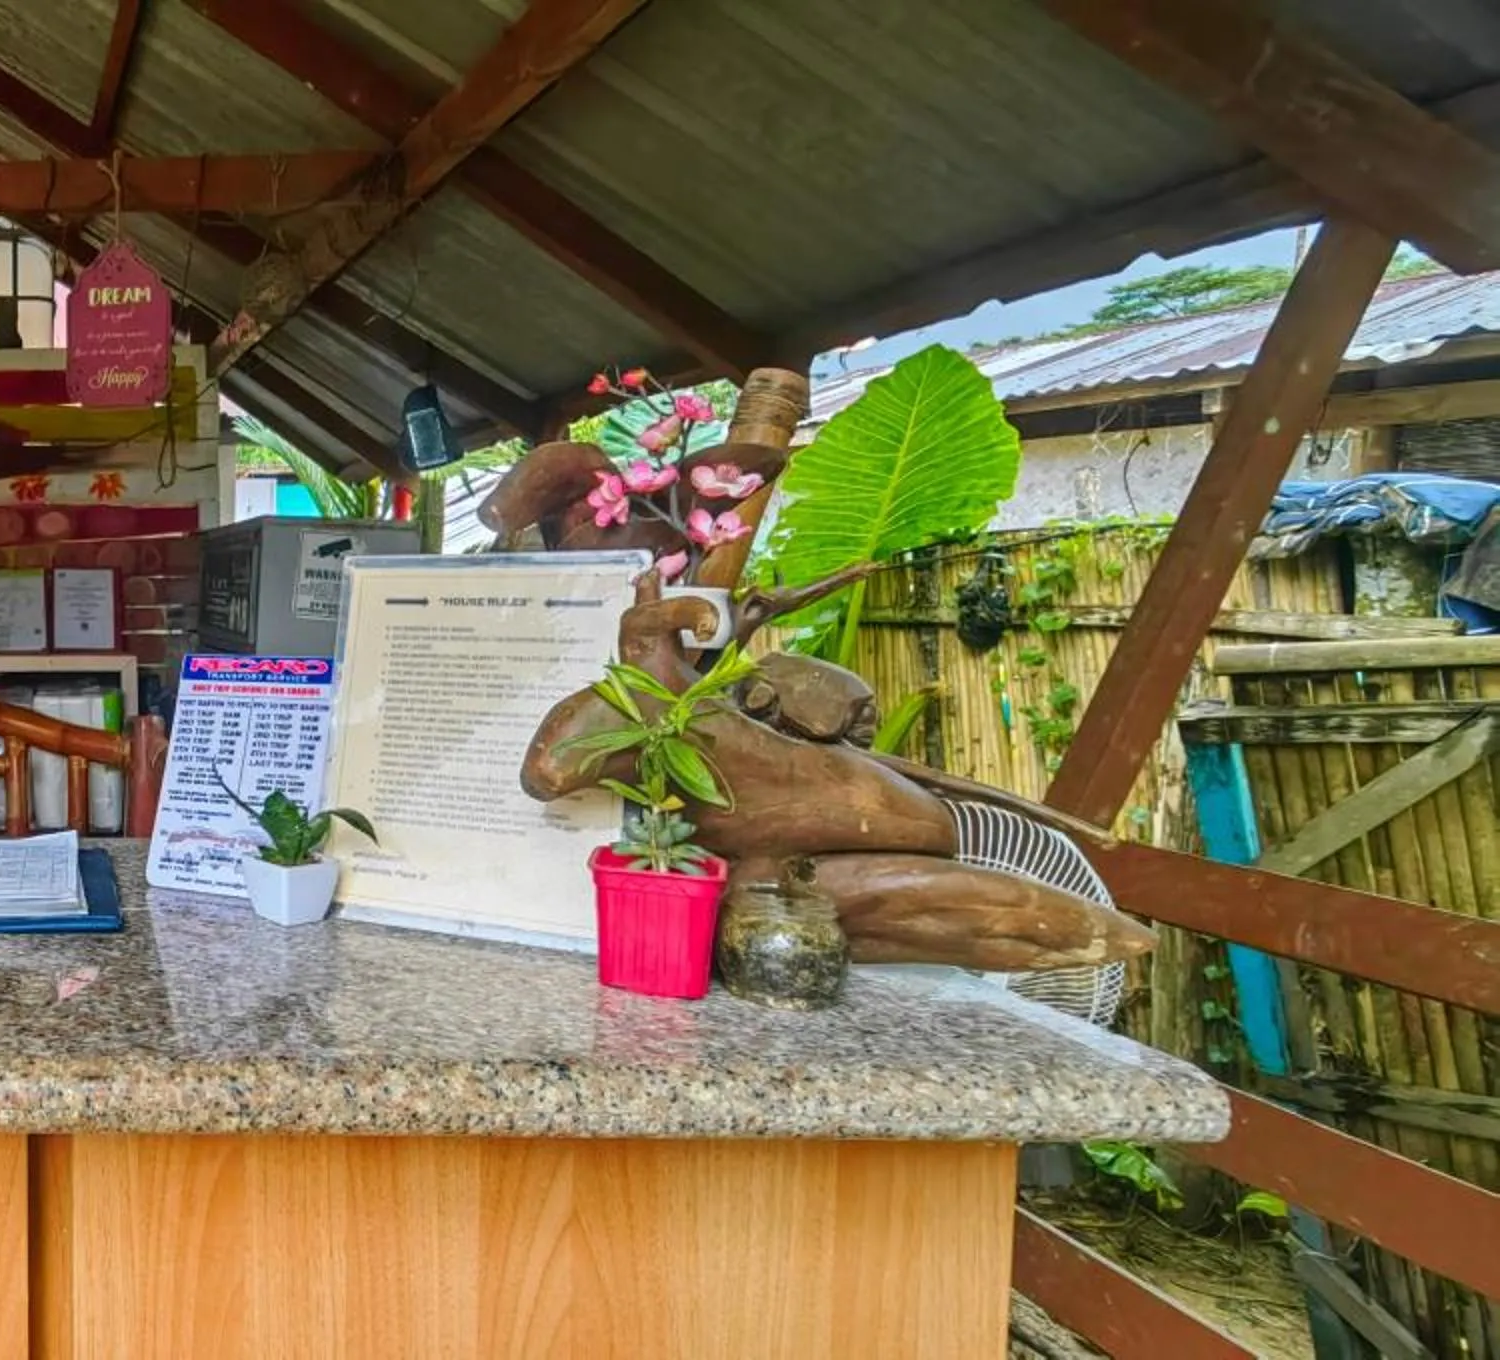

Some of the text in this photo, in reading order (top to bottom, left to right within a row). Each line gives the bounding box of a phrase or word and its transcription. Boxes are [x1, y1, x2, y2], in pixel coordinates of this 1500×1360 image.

[88, 287, 151, 306] DREAM
[88, 364, 149, 390] Happy
[304, 568, 342, 581] WARNI
[207, 673, 309, 683] TRANSPORT SERVICE
